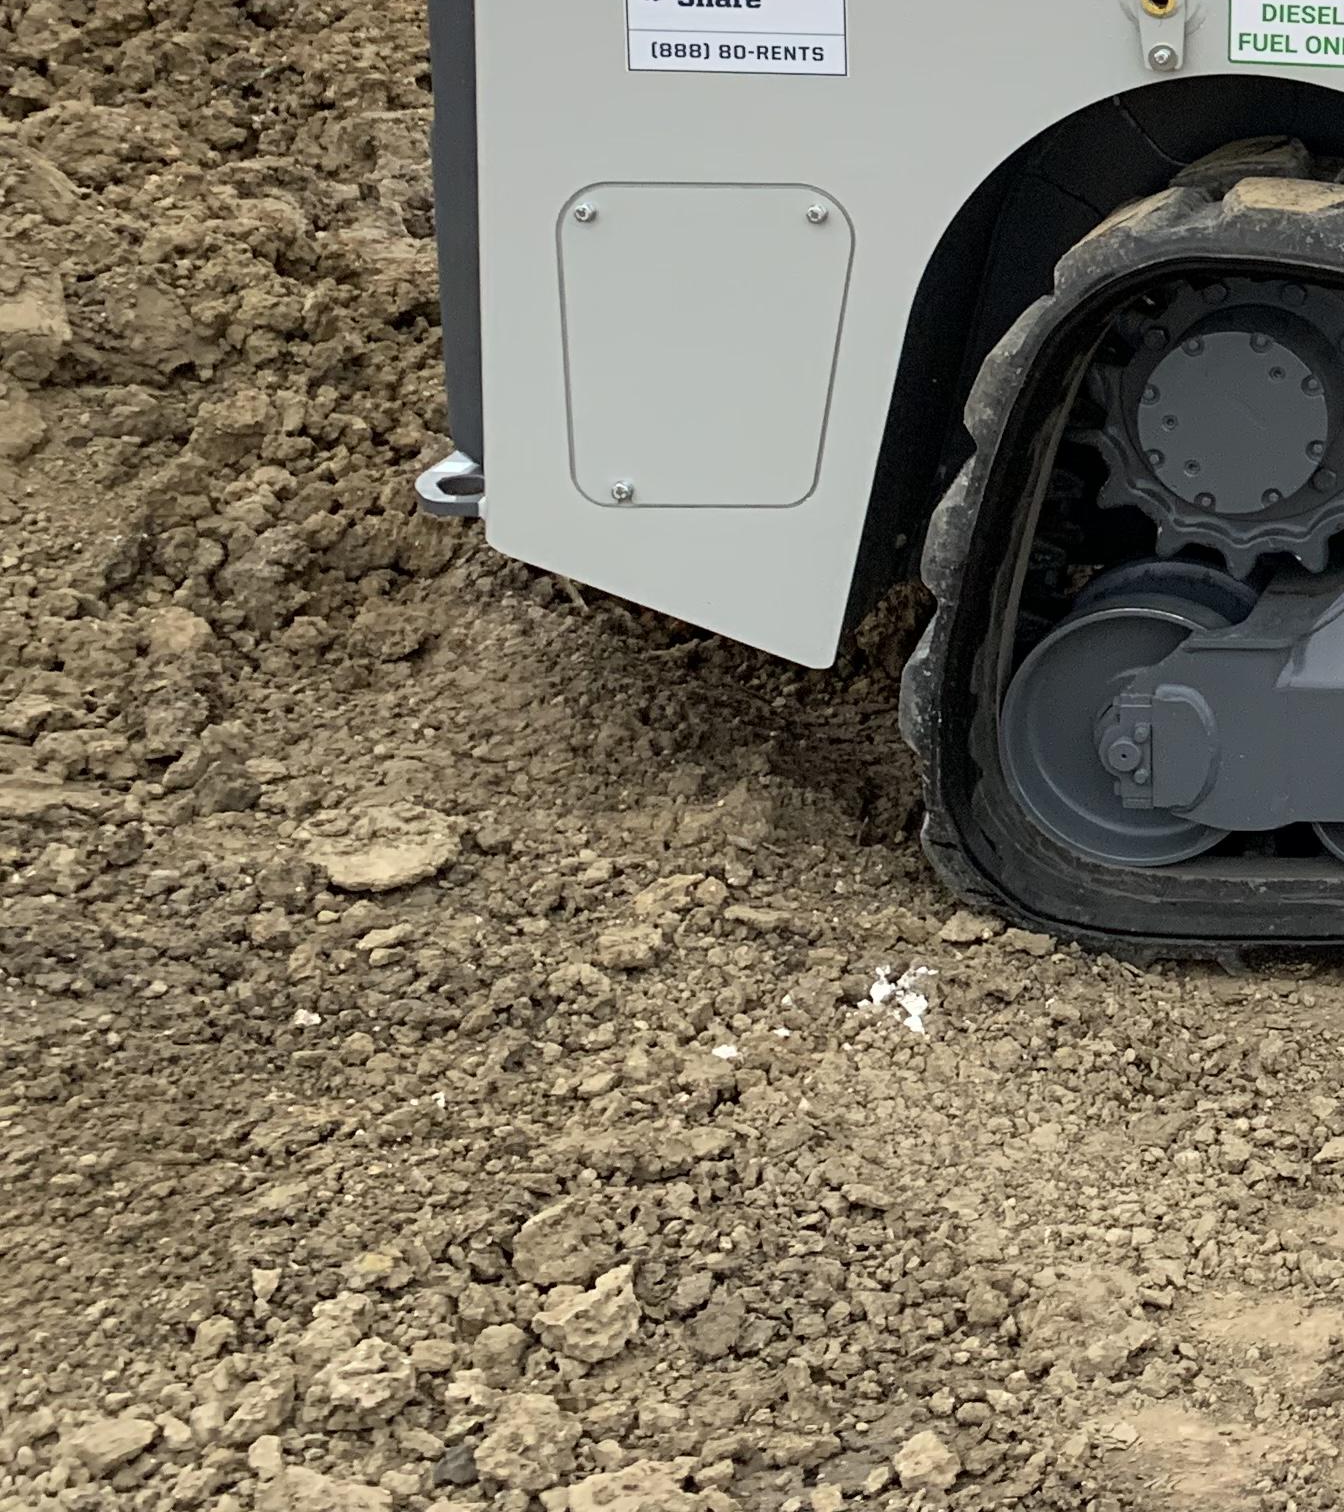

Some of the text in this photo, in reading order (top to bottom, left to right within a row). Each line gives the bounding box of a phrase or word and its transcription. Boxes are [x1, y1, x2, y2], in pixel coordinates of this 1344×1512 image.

[651, 41, 825, 62] (888) 80-RENTS
[1238, 33, 1298, 54] FUEL
